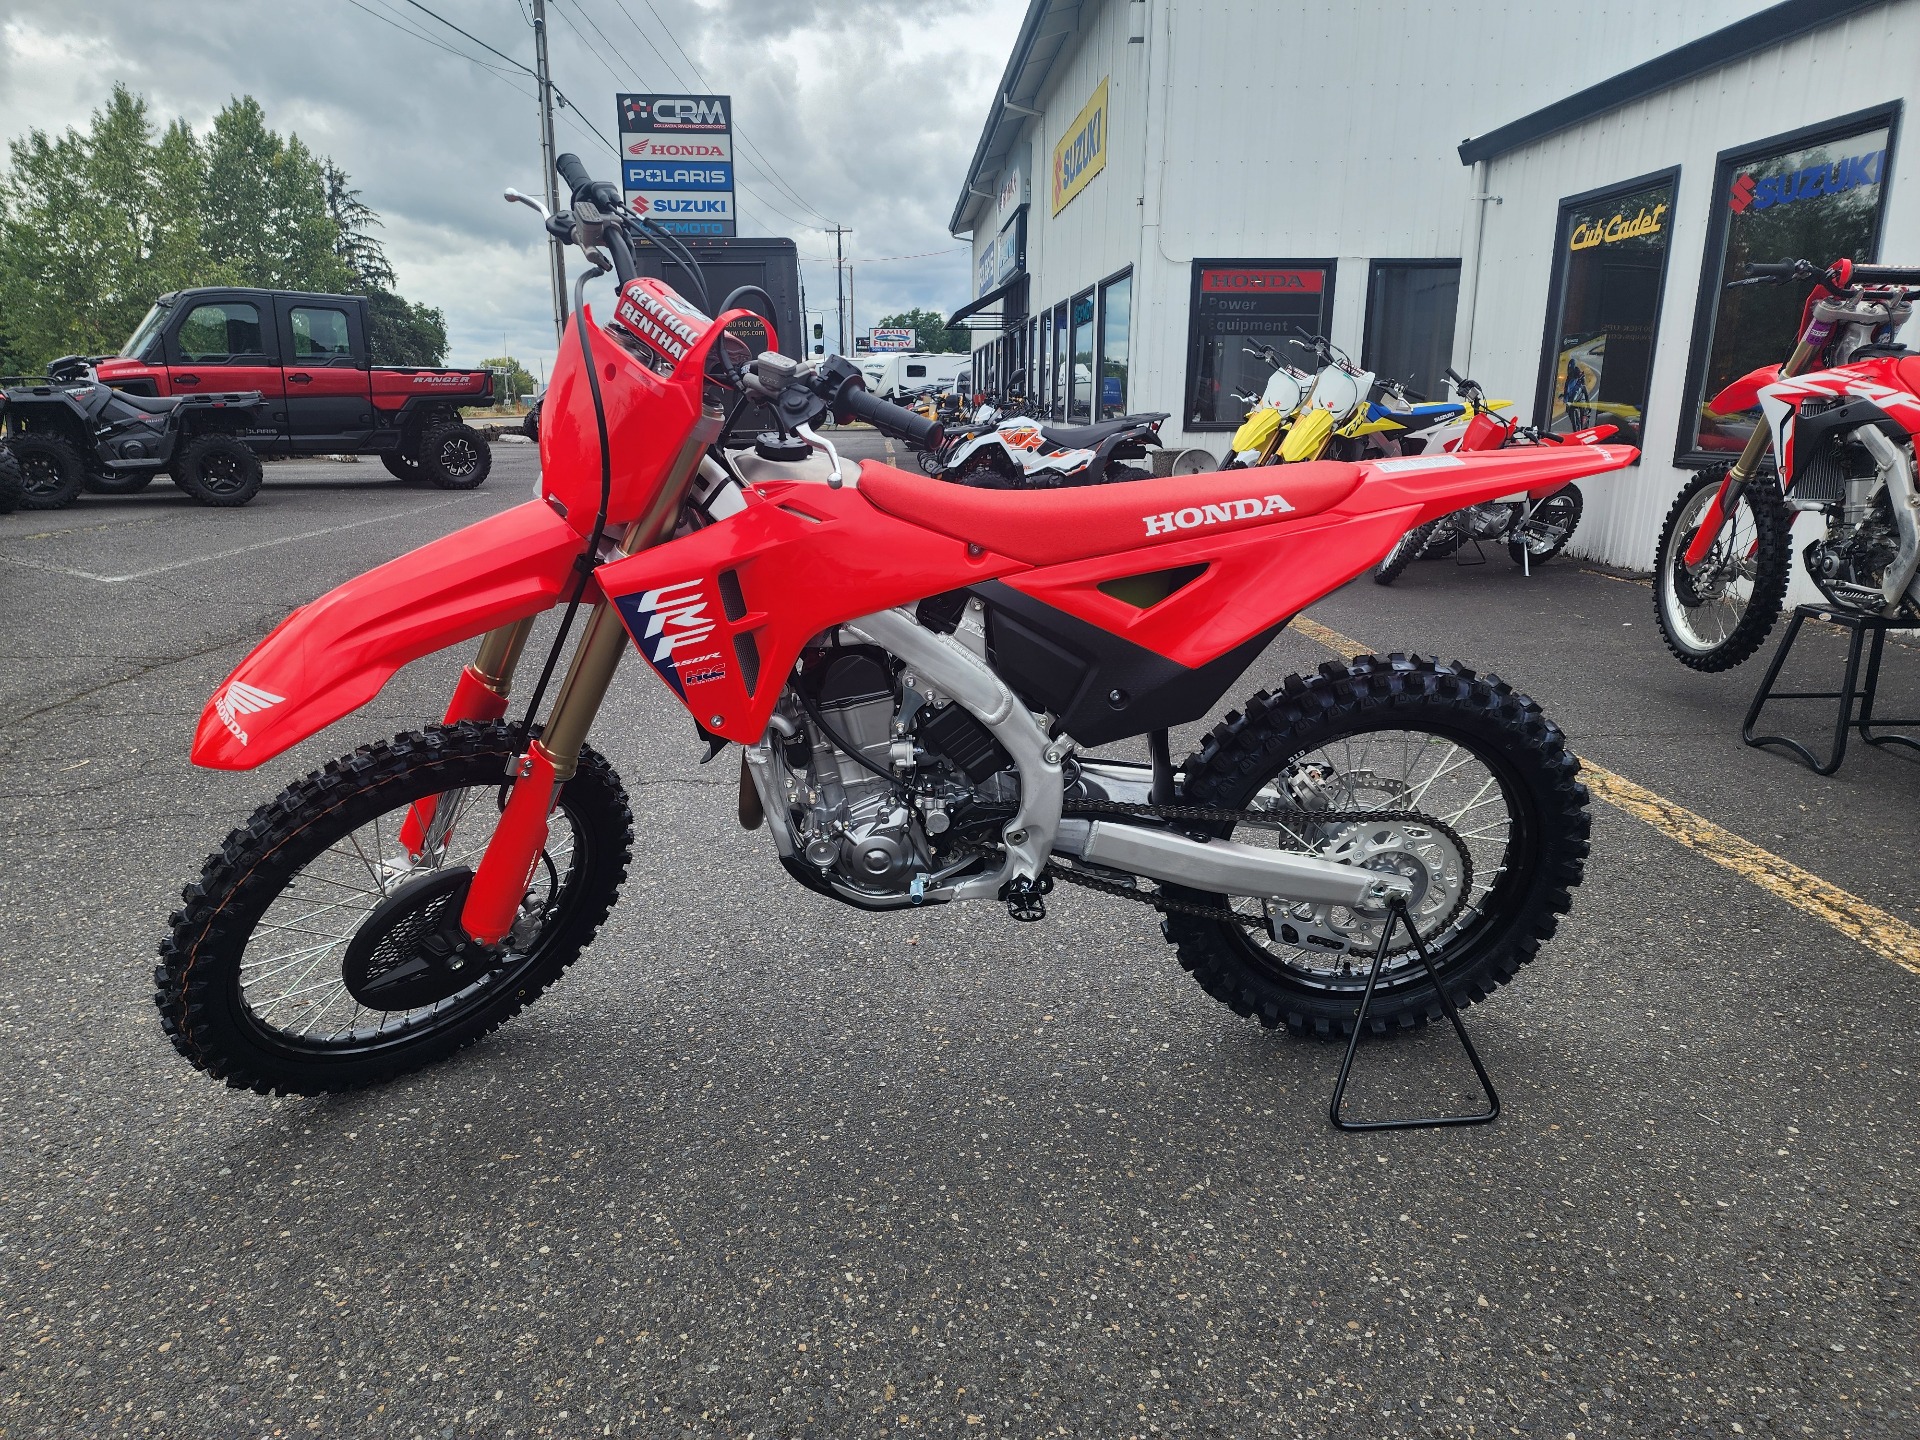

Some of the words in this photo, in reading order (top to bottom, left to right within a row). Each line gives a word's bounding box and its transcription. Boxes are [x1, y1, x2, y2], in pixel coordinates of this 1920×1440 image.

[652, 99, 726, 125] CRM
[650, 144, 724, 156] HONDA
[1063, 106, 1101, 190] SUZUKI
[629, 169, 726, 183] POLARIS
[1753, 149, 1886, 209] SUZUKI
[653, 199, 726, 213] SUZUKI
[657, 222, 723, 234] FMOTO
[1570, 219, 1603, 251] Cub
[1604, 203, 1667, 243] Cadet
[1210, 274, 1305, 288] HONDA
[1209, 297, 1257, 311] Power
[626, 285, 700, 347] RENTHAL
[1433, 411, 1456, 423] SUZUKI
[1142, 494, 1296, 537] HONDA
[637, 578, 717, 663] CRF
[667, 651, 722, 669] 450R
[686, 663, 726, 684] HRC
[214, 696, 249, 747] HONDA
[1287, 749, 1306, 764] DID
